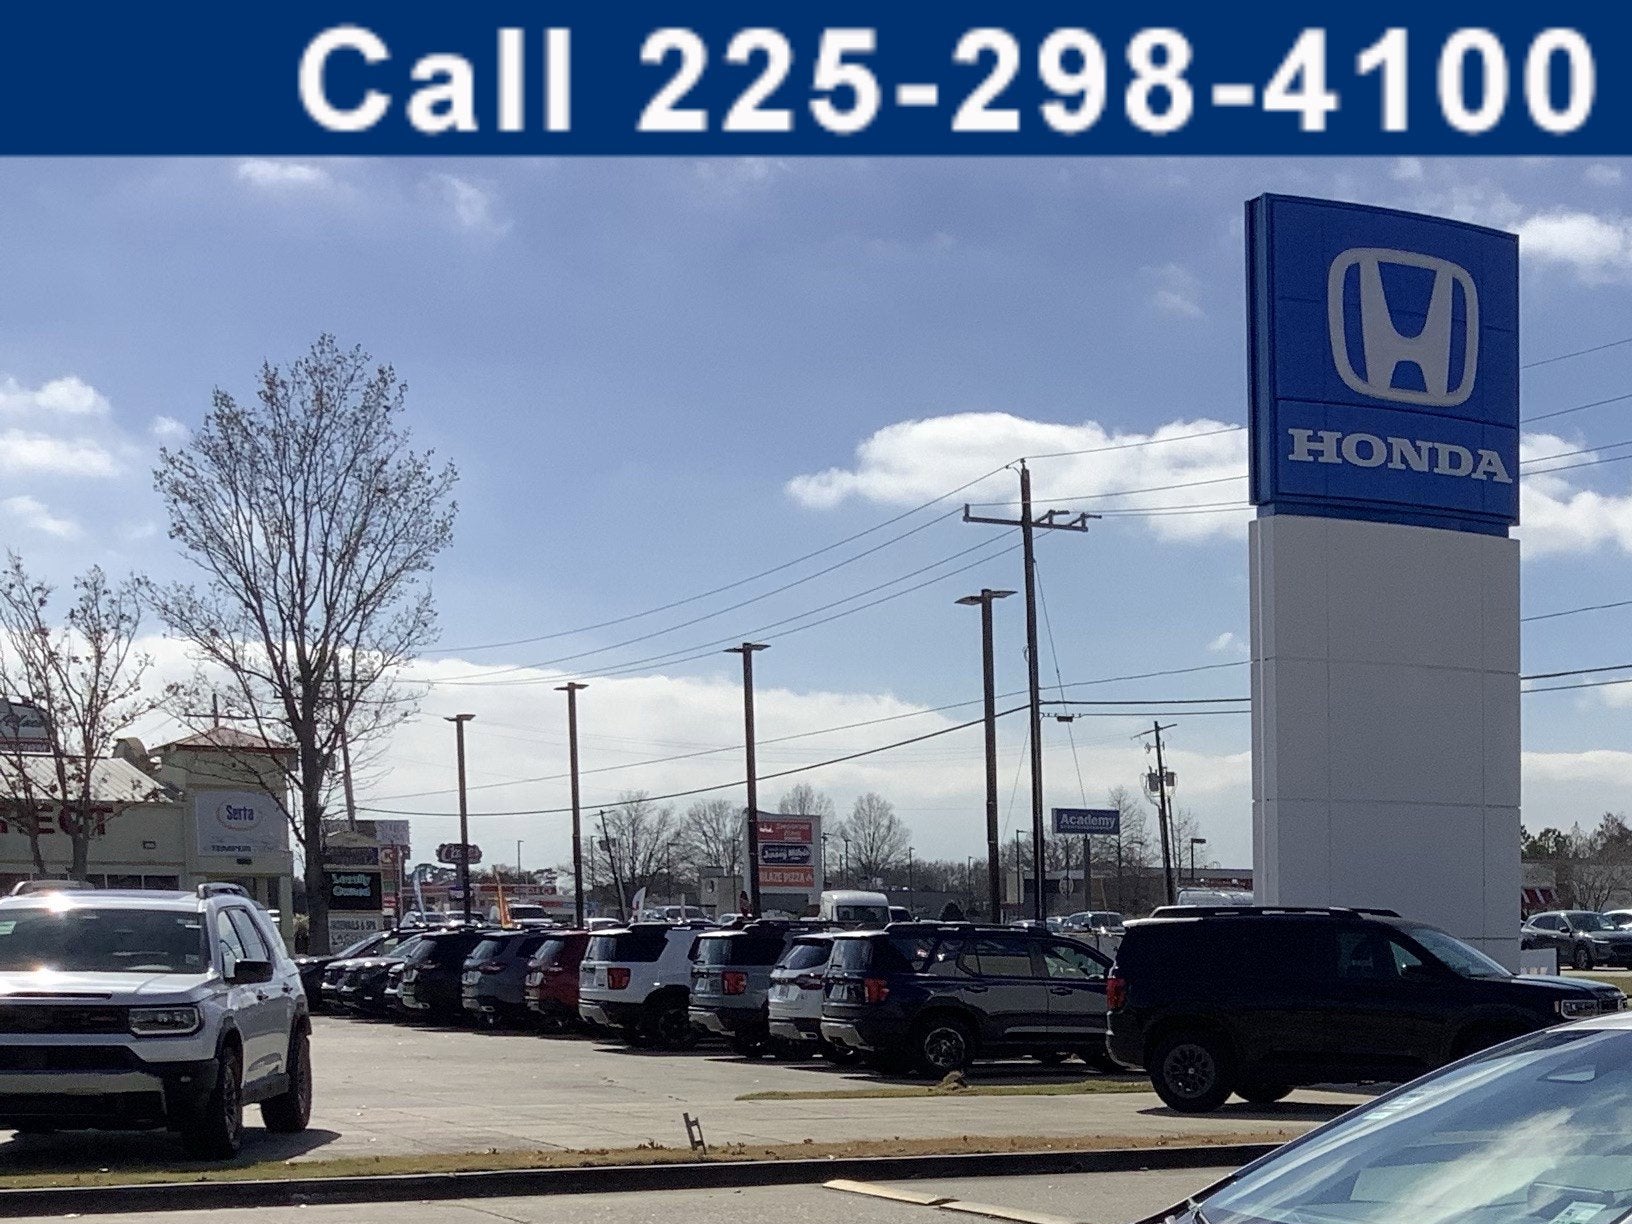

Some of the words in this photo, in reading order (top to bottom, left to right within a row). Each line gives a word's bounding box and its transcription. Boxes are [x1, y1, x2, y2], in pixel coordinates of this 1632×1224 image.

[1288, 427, 1513, 484] HONDA
[226, 804, 255, 821] Serta
[1060, 812, 1117, 830] Academy
